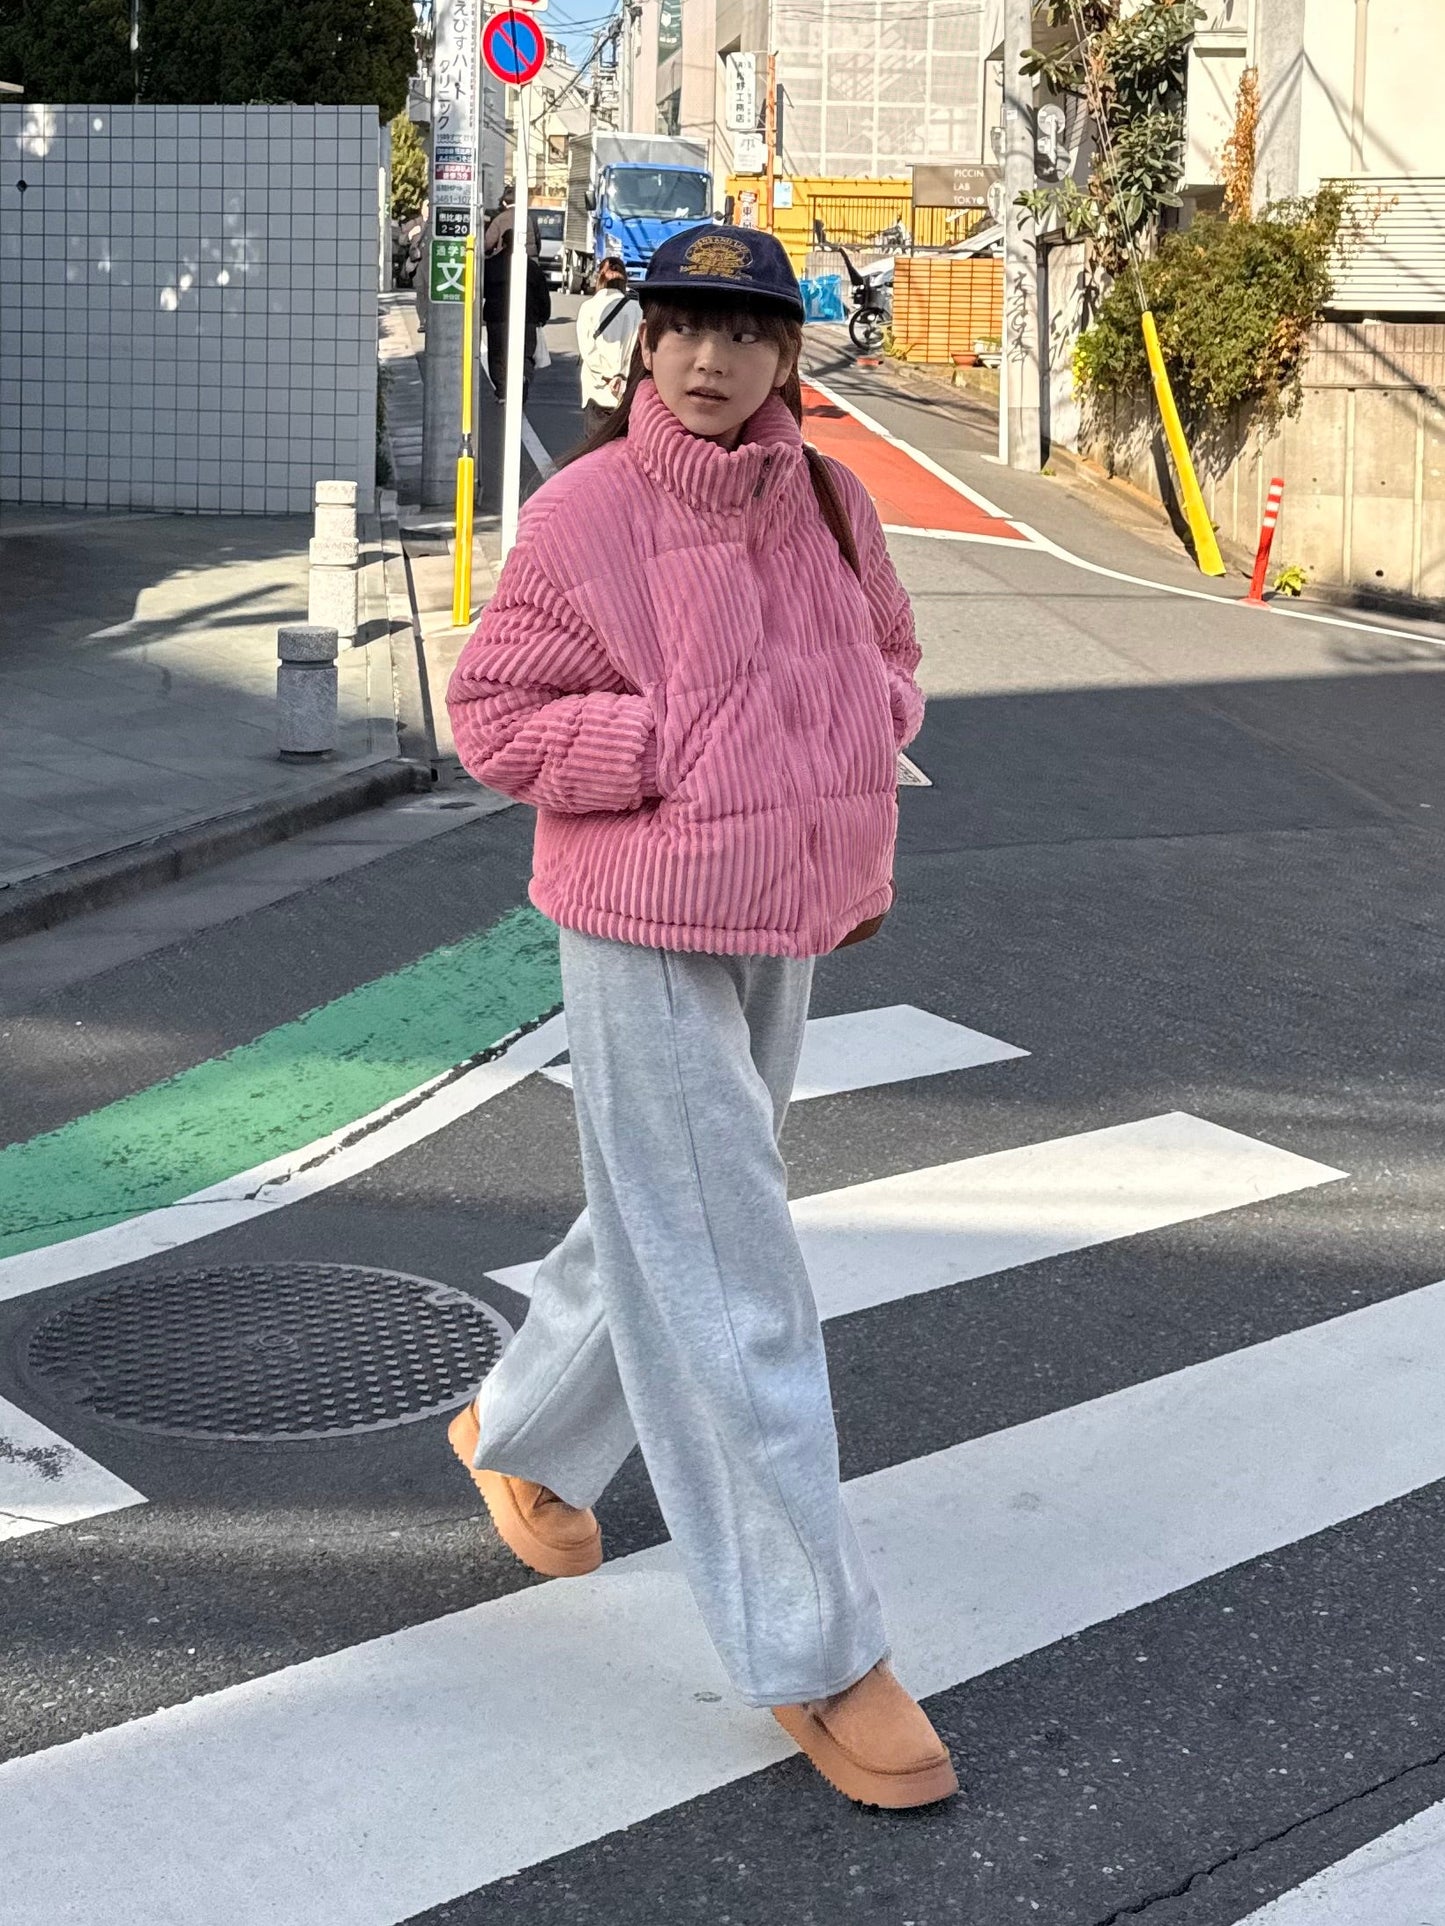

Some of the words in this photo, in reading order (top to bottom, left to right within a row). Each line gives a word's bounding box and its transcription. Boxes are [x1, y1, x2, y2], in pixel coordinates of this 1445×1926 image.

[453, 0, 468, 100] えびすハート
[438, 59, 451, 130] クリニック
[953, 168, 985, 178] PICCIN
[953, 182, 971, 192] LAB
[953, 196, 985, 205] TOKYO
[441, 225, 468, 234] 2-20
[436, 258, 466, 292] 文
